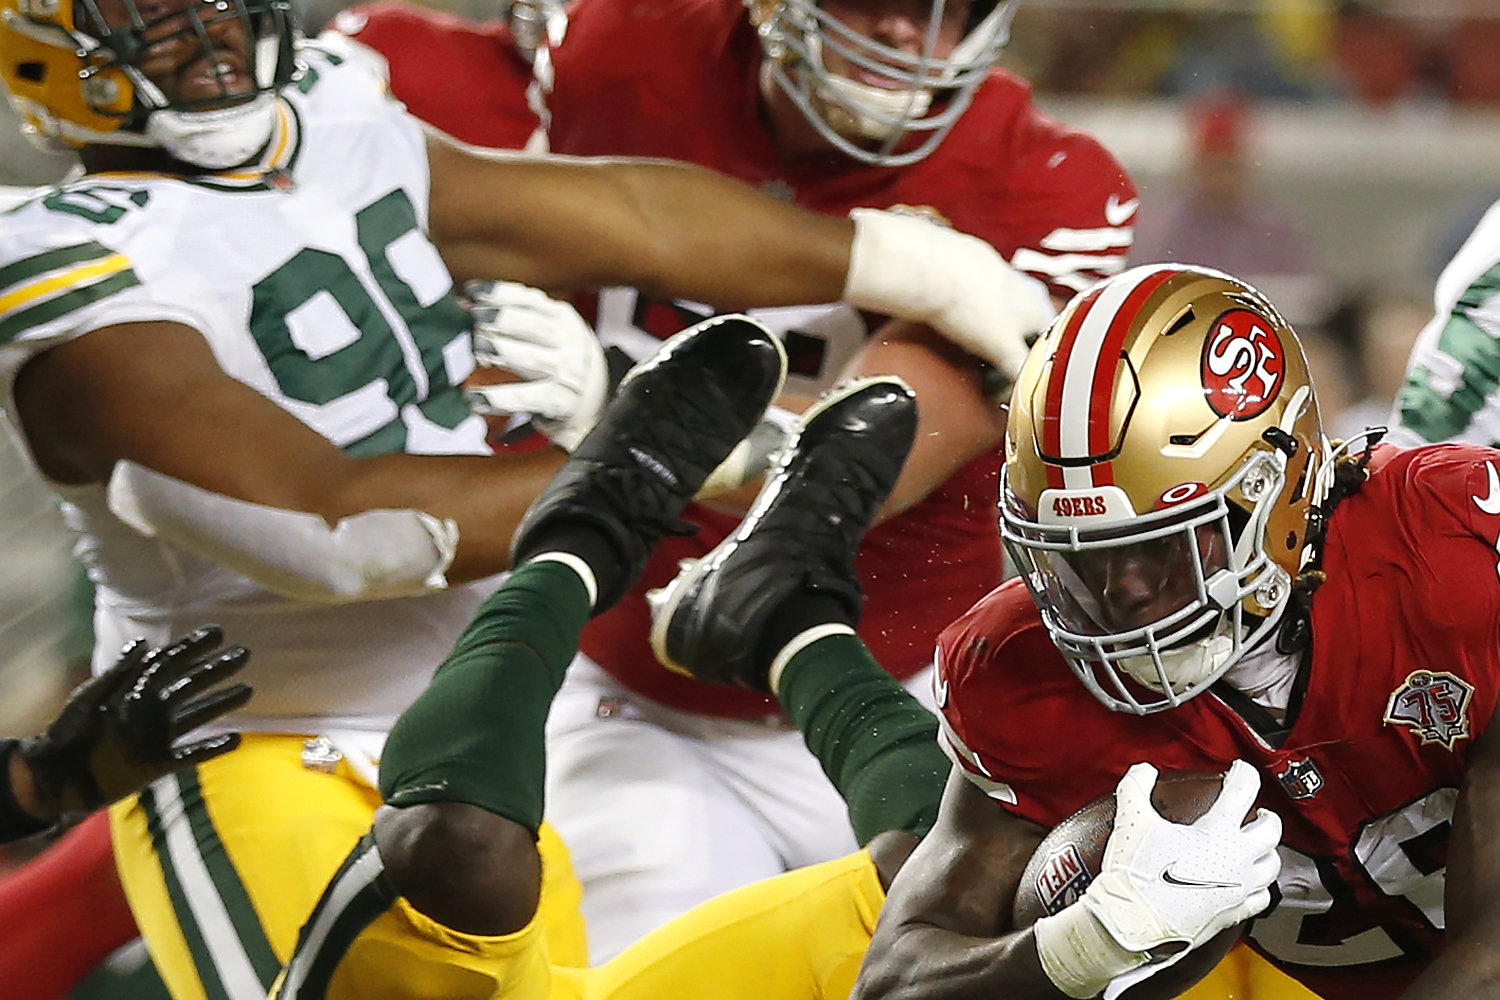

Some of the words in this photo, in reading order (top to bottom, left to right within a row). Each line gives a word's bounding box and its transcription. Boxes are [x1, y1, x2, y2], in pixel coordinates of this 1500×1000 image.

[1053, 496, 1107, 517] 49ERS
[1401, 682, 1460, 728] 75
[1039, 849, 1081, 899] NFL
